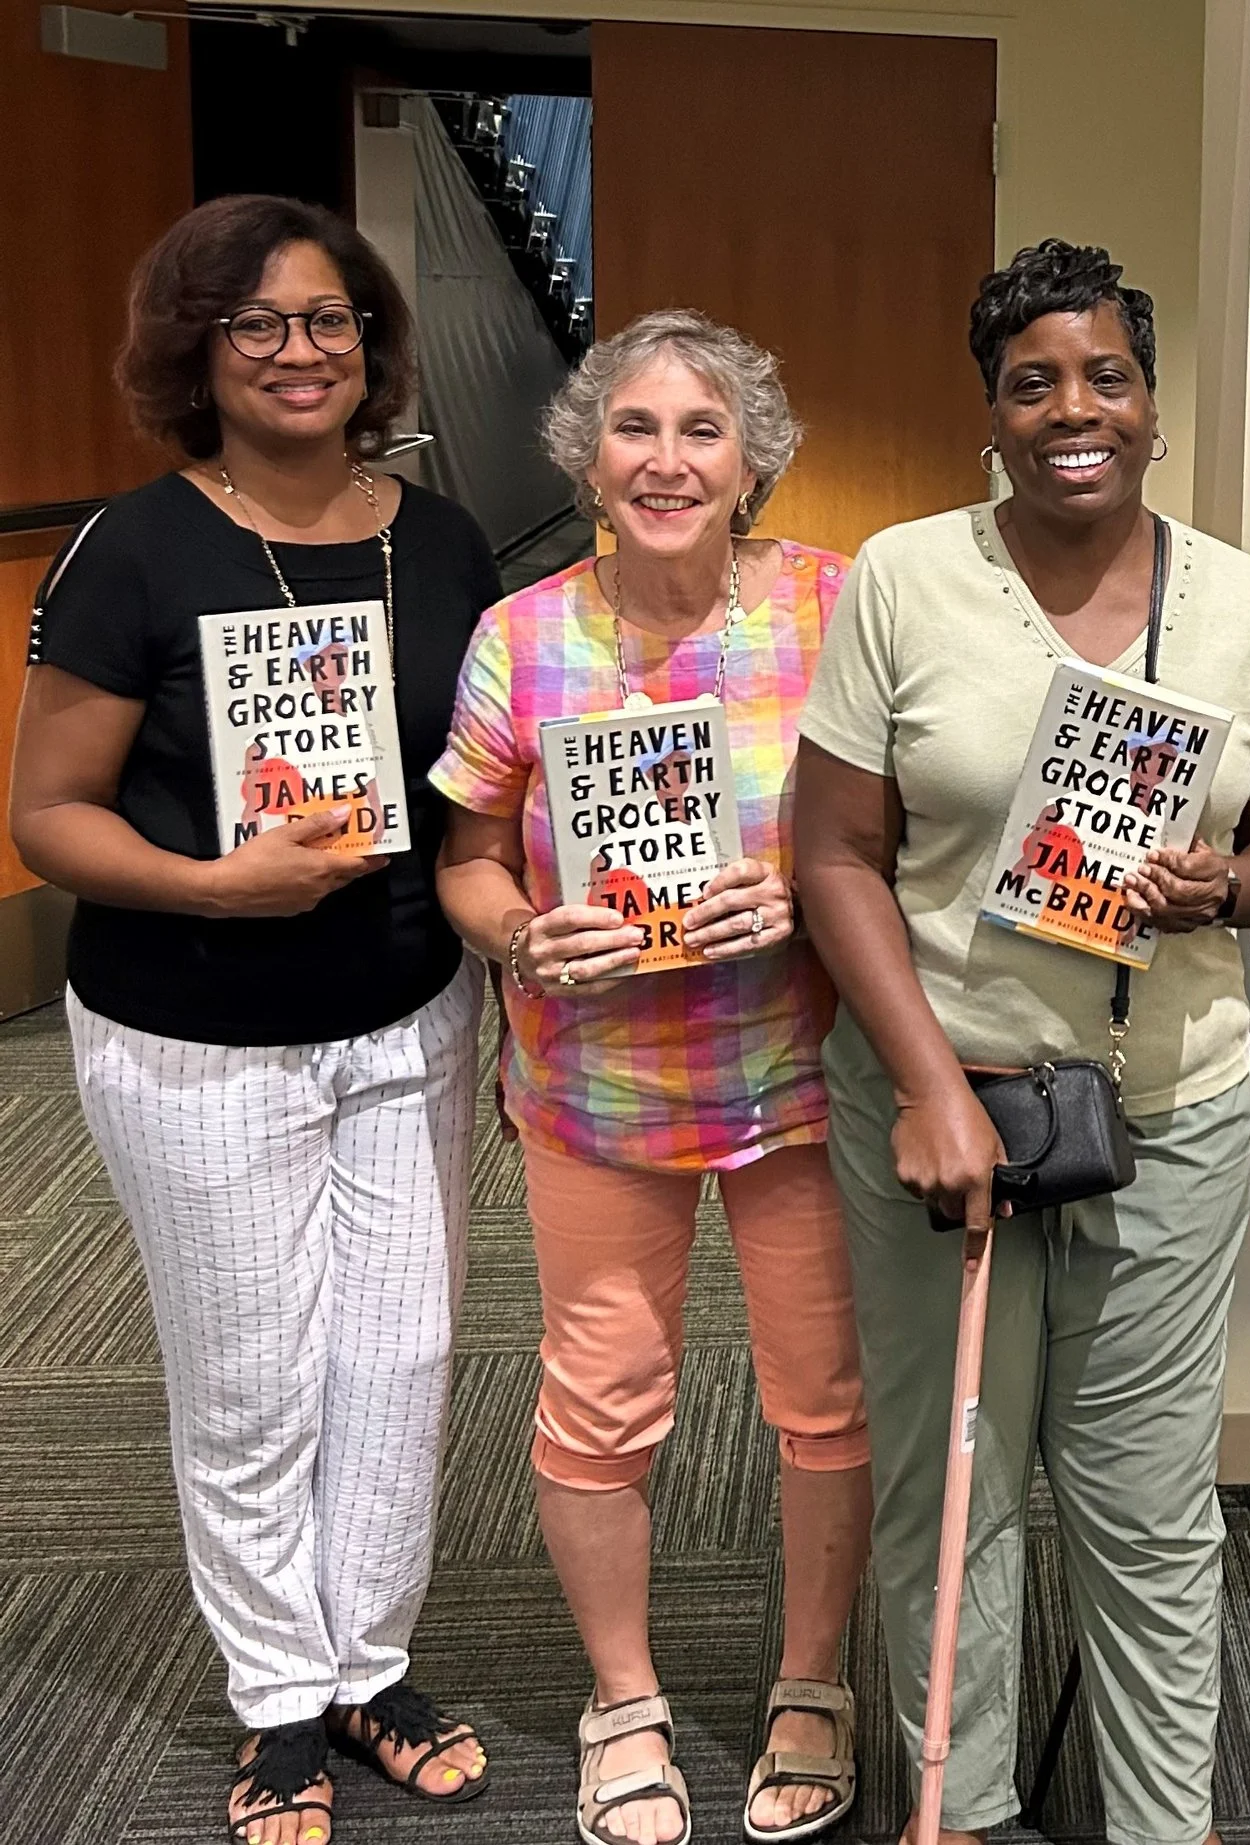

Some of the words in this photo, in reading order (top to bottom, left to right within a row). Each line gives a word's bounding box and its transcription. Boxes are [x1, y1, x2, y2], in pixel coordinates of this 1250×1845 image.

[223, 625, 238, 657] THE
[243, 615, 369, 654] HEAVEN
[228, 663, 253, 690] &
[267, 650, 371, 686] EARTH
[227, 685, 377, 727] GROCERY
[1064, 683, 1084, 715] THE
[251, 724, 362, 761] STORE
[585, 721, 712, 765] HEAVEN
[1081, 690, 1210, 755] HEAVEN
[564, 736, 579, 769] THE
[1054, 723, 1081, 749] &
[1089, 731, 1197, 787] EARTH
[254, 772, 369, 813] JAMES
[570, 774, 596, 801] &
[609, 757, 714, 797] EARTH
[1041, 756, 1189, 821] GROCERY
[571, 792, 721, 839] GROCERY
[1045, 797, 1157, 849] STORE
[596, 832, 706, 873] STORE
[1027, 841, 1127, 895] JAME
[783, 1688, 822, 1699] KURU
[613, 1708, 650, 1727] KURU
